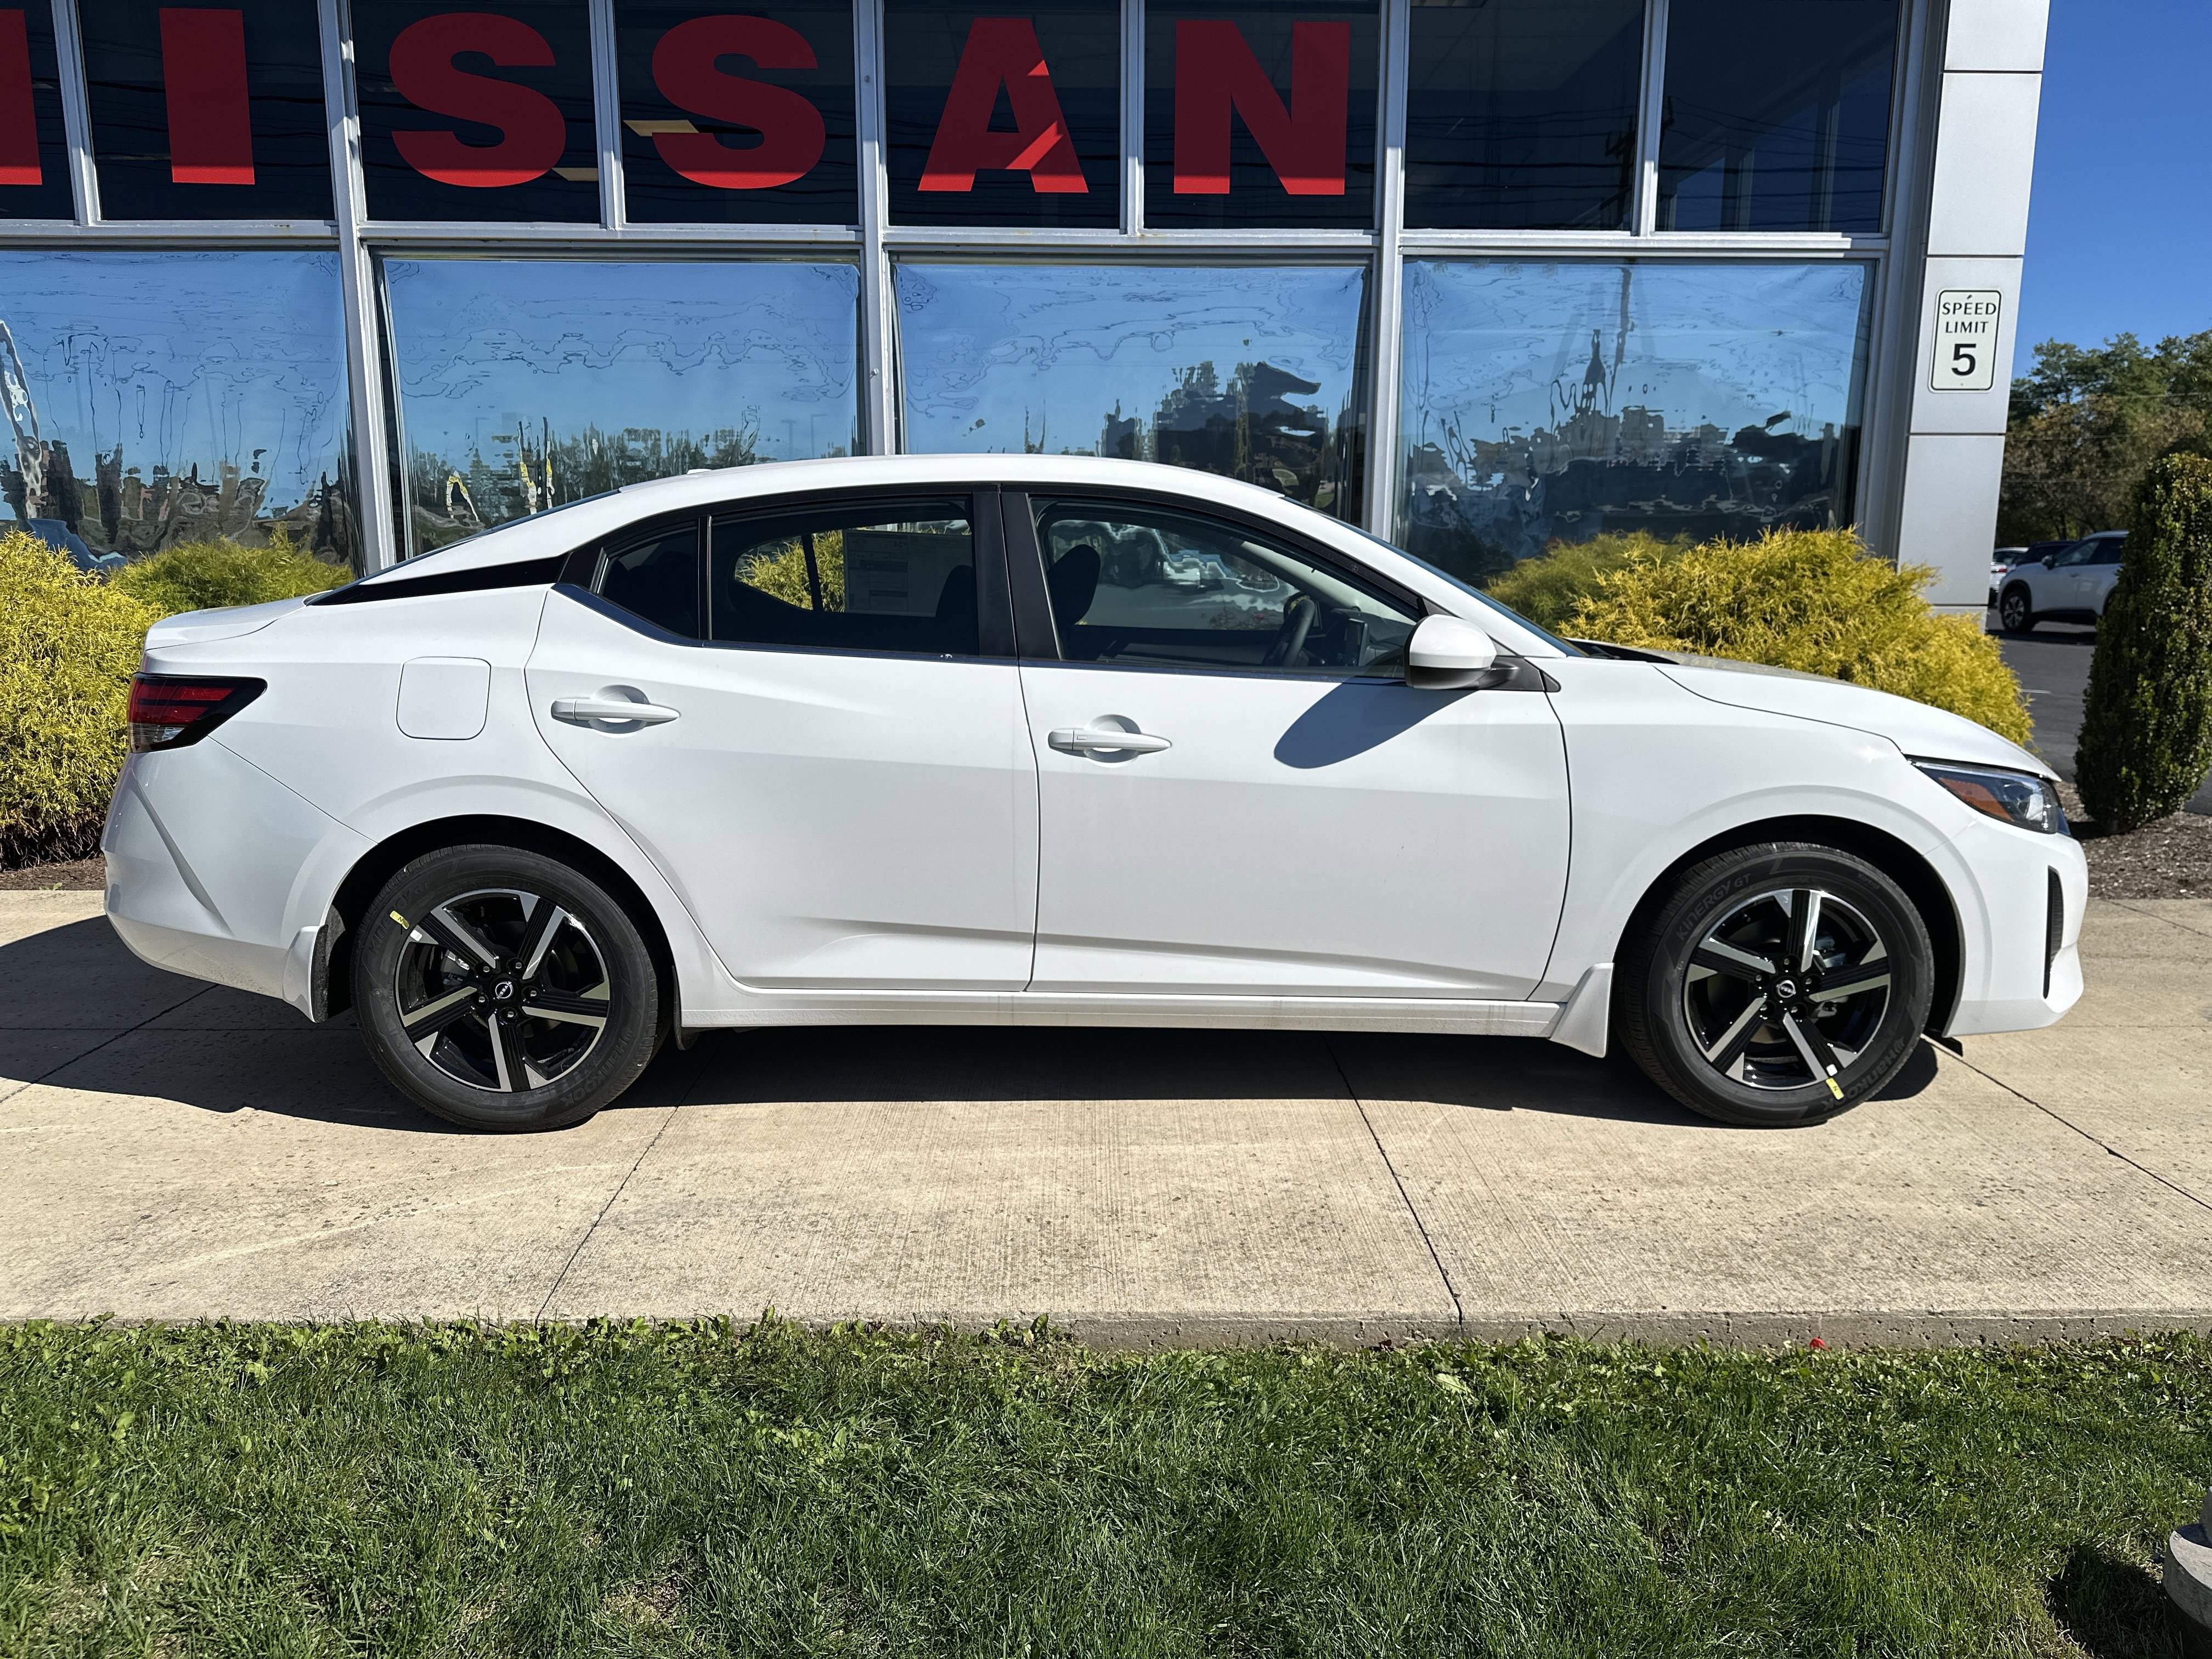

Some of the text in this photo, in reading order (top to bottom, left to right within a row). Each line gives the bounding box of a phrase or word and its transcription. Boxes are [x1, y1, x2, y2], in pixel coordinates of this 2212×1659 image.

[0, 8, 1350, 195] ISSAN
[1942, 302, 1996, 315] SPEED
[1945, 321, 1989, 334] LIMIT
[1951, 343, 1977, 376] 5
[1734, 873, 1751, 887] GT
[369, 889, 411, 953] KINEGY
